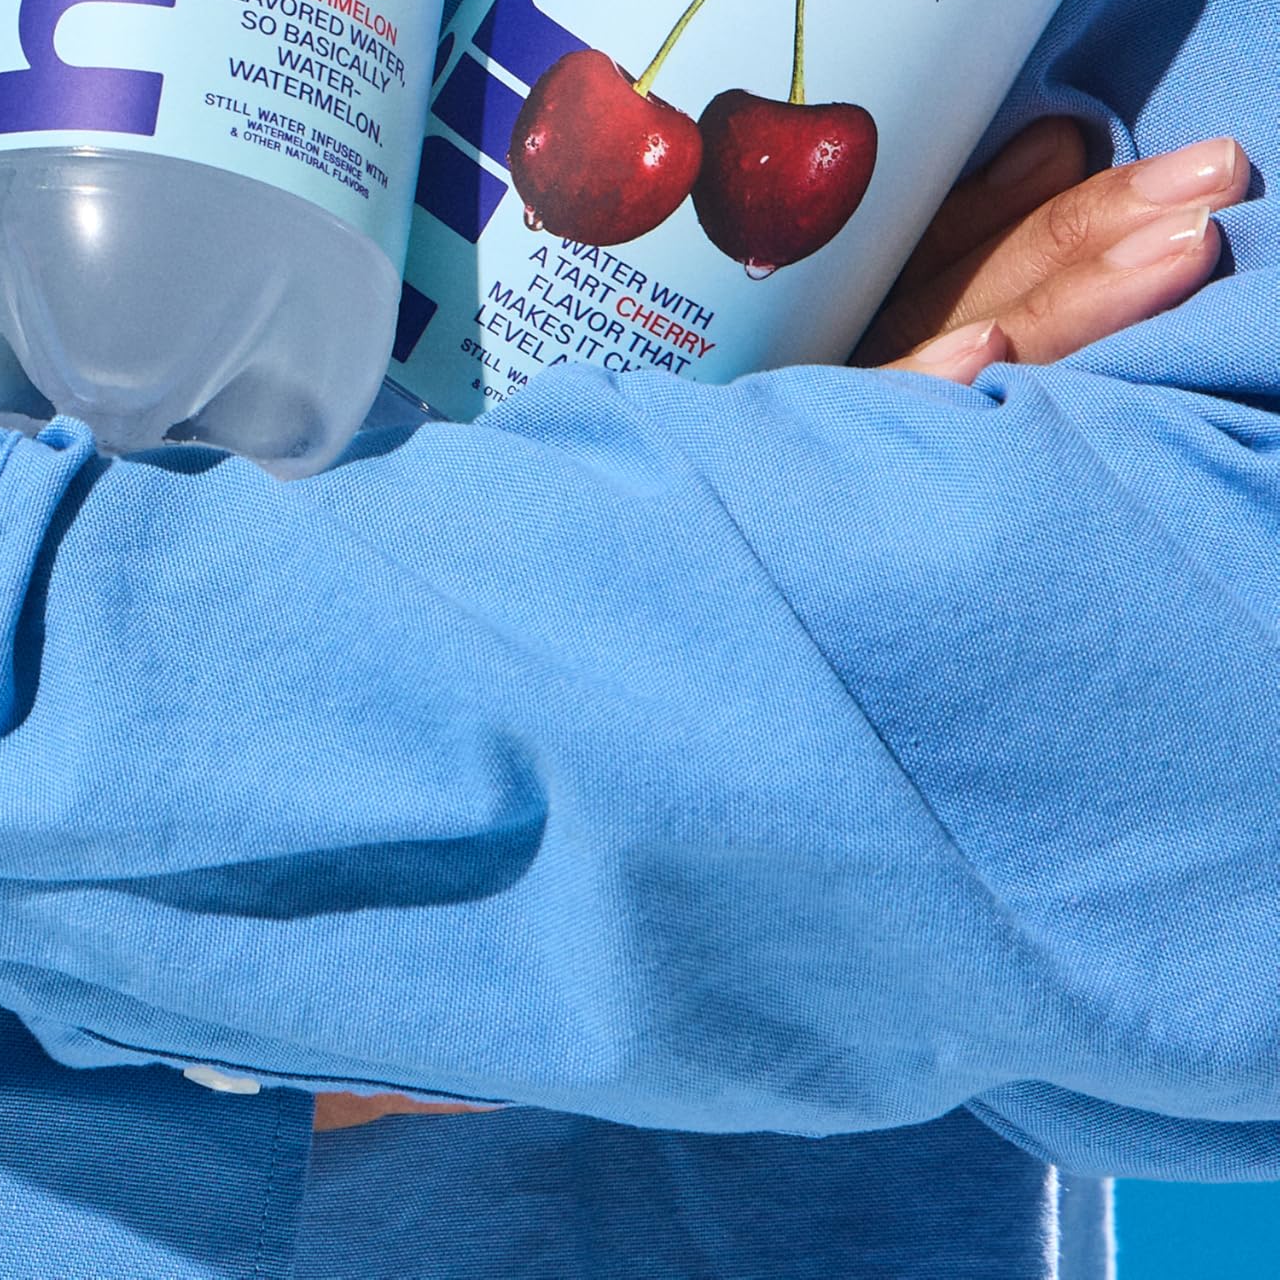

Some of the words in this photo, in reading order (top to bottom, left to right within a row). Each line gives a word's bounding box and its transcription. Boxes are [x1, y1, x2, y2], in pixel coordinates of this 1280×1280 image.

[241, 10, 277, 35] SO
[284, 23, 391, 93] BASICALLY
[277, 46, 362, 98] WATER-
[350, 24, 406, 88] WATER,
[229, 57, 384, 148] WATERMELON.
[204, 93, 251, 116] STILL
[258, 107, 306, 136] WATER
[311, 128, 363, 167] INFUSED
[365, 159, 388, 189] WITH
[230, 127, 238, 137] &
[243, 131, 281, 152] OTHER
[285, 146, 330, 175] NATURAL
[332, 170, 370, 199] FLAVORS
[246, 119, 320, 156] WATERMELON
[323, 150, 363, 180] ESSENCE
[488, 281, 575, 345] MAKES
[575, 335, 604, 360] IT
[529, 246, 548, 268] A
[554, 255, 616, 304] TART
[616, 296, 716, 358] CHERRY
[561, 238, 648, 294] WATER
[650, 282, 715, 330] WITH
[460, 338, 501, 373] STILL
[474, 304, 545, 364] LEVEL
[528, 274, 625, 344] FLAVOR
[628, 331, 691, 375] THAT
[472, 379, 480, 390] &
